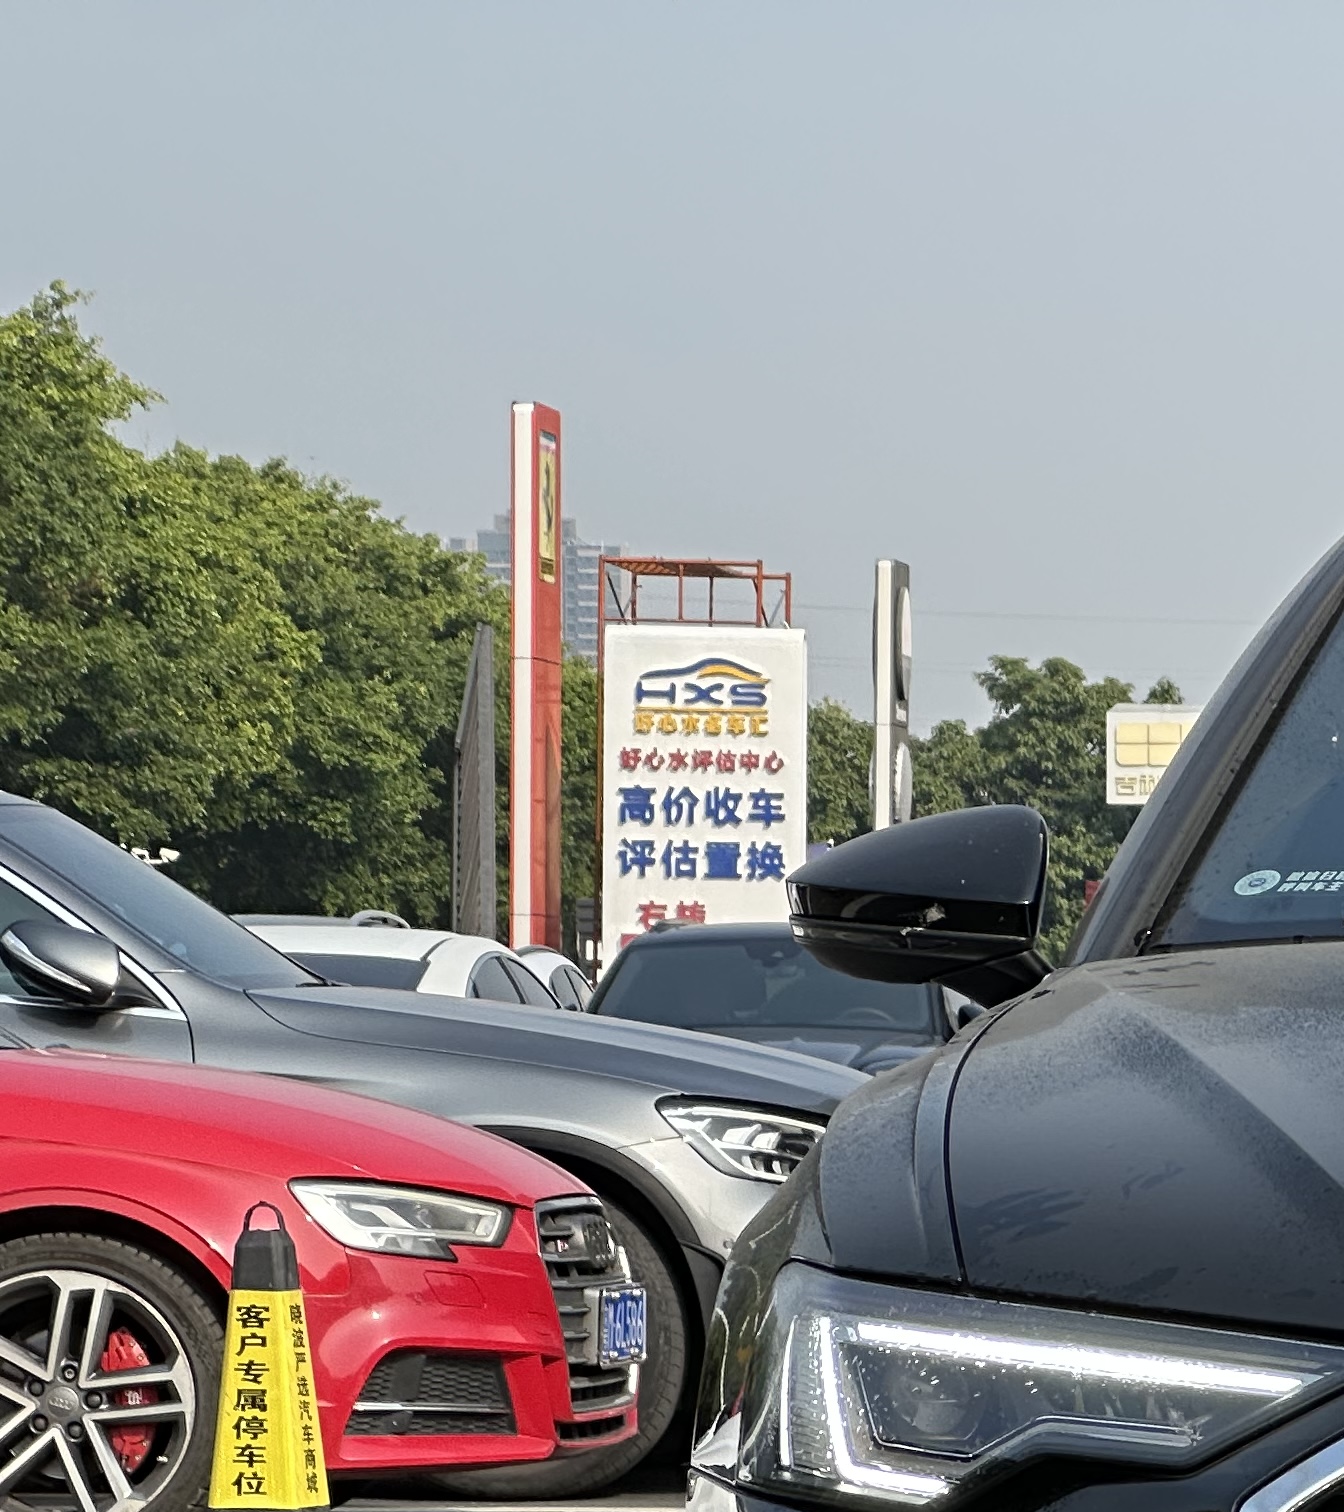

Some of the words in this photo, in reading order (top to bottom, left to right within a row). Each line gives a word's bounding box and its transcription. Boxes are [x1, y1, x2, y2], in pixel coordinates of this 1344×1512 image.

[635, 681, 768, 707] HXS
[619, 747, 785, 775] 好心水评估中心
[616, 784, 786, 829] 高价收车
[616, 837, 786, 882] 评估置换
[230, 1303, 271, 1497] 客户专属停车位
[288, 1303, 320, 1495] 晓波严选汽车商城
